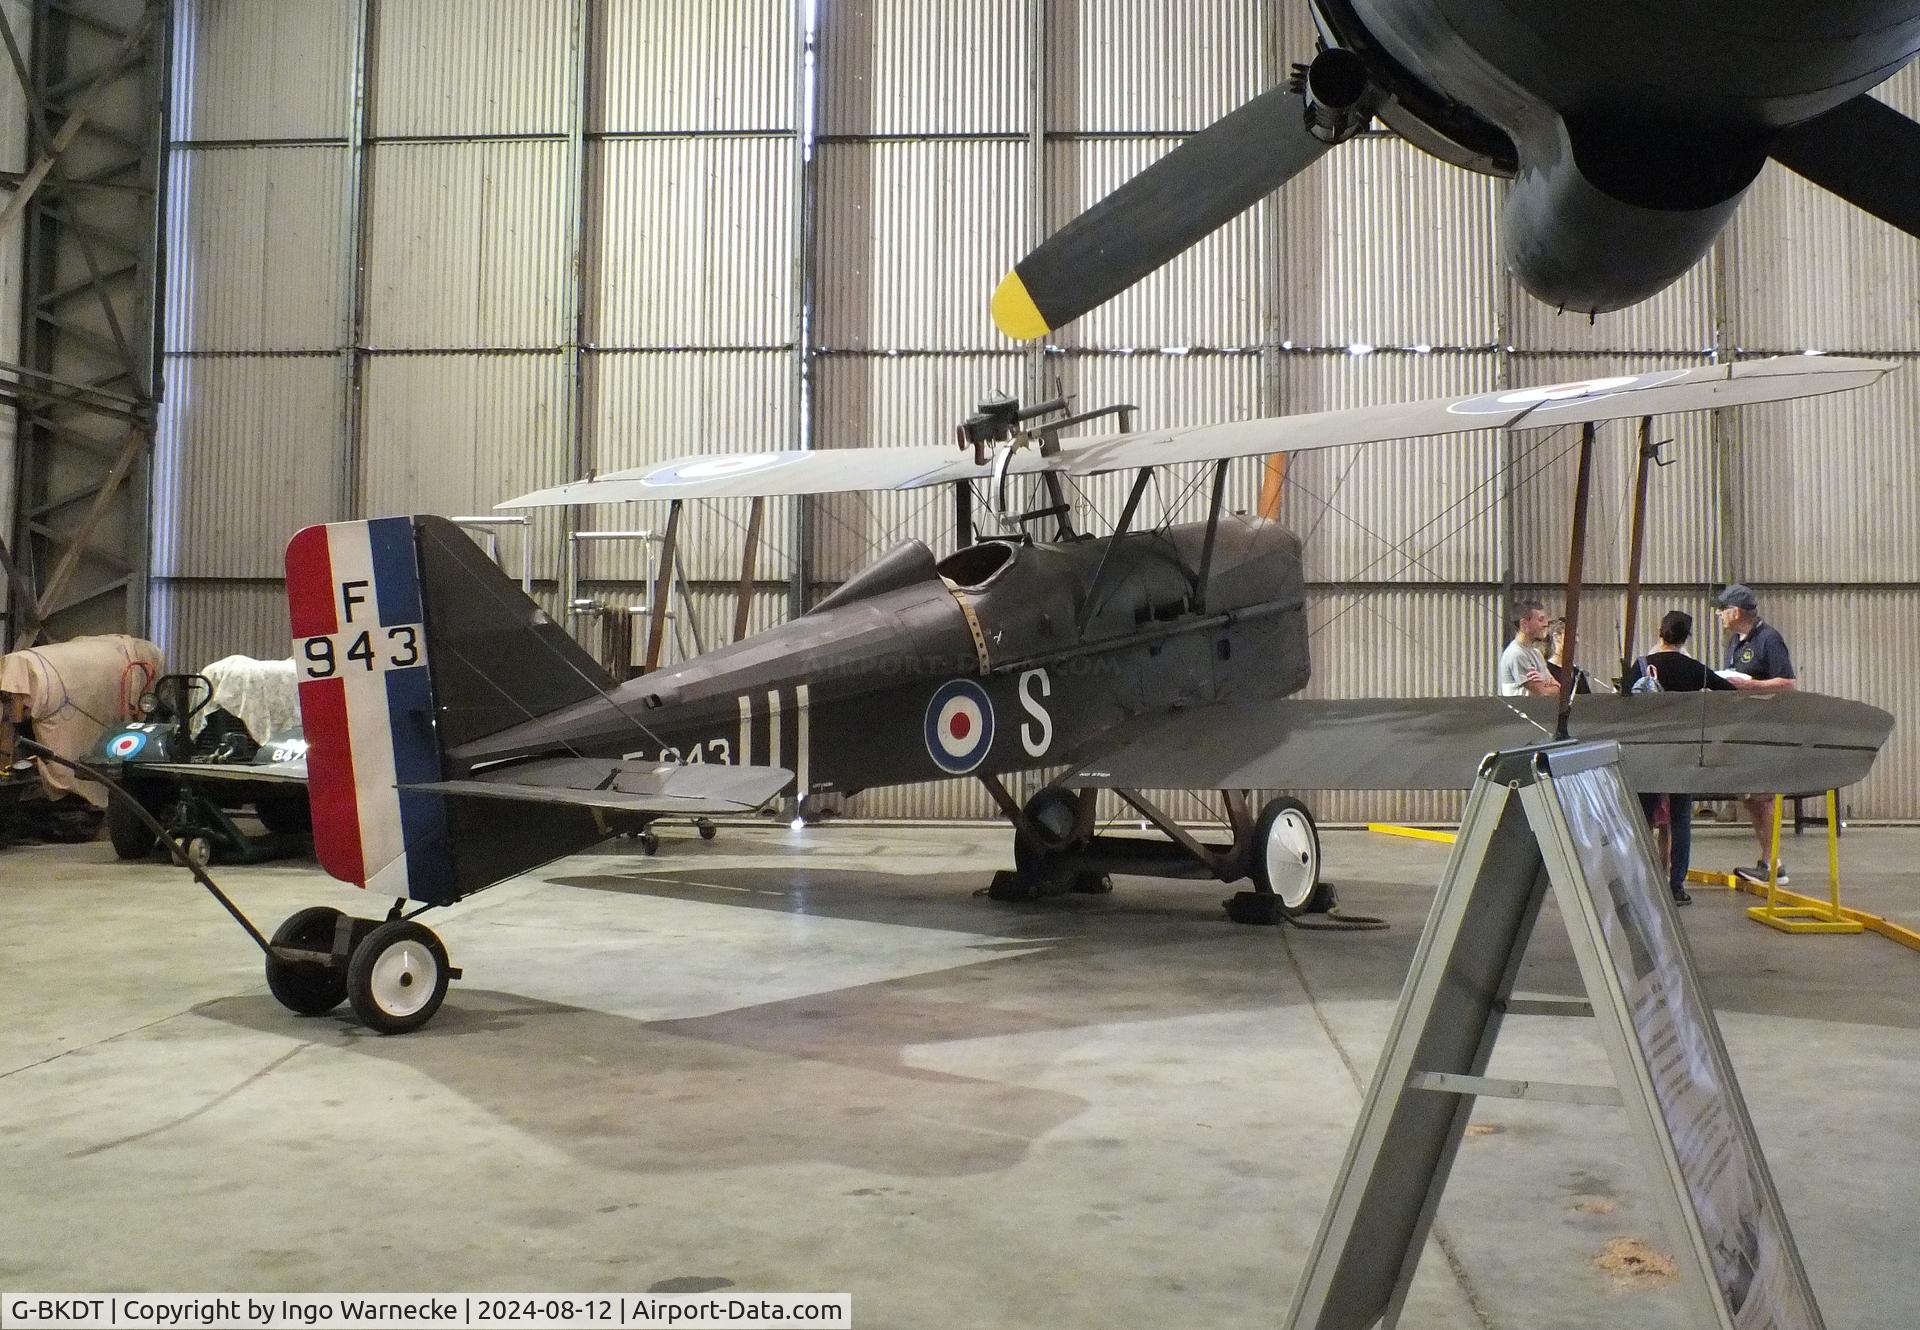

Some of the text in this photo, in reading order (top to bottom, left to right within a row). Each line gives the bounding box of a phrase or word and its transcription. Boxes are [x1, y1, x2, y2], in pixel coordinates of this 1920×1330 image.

[341, 580, 369, 623] F
[304, 626, 419, 678] 943
[1019, 667, 1053, 758] S
